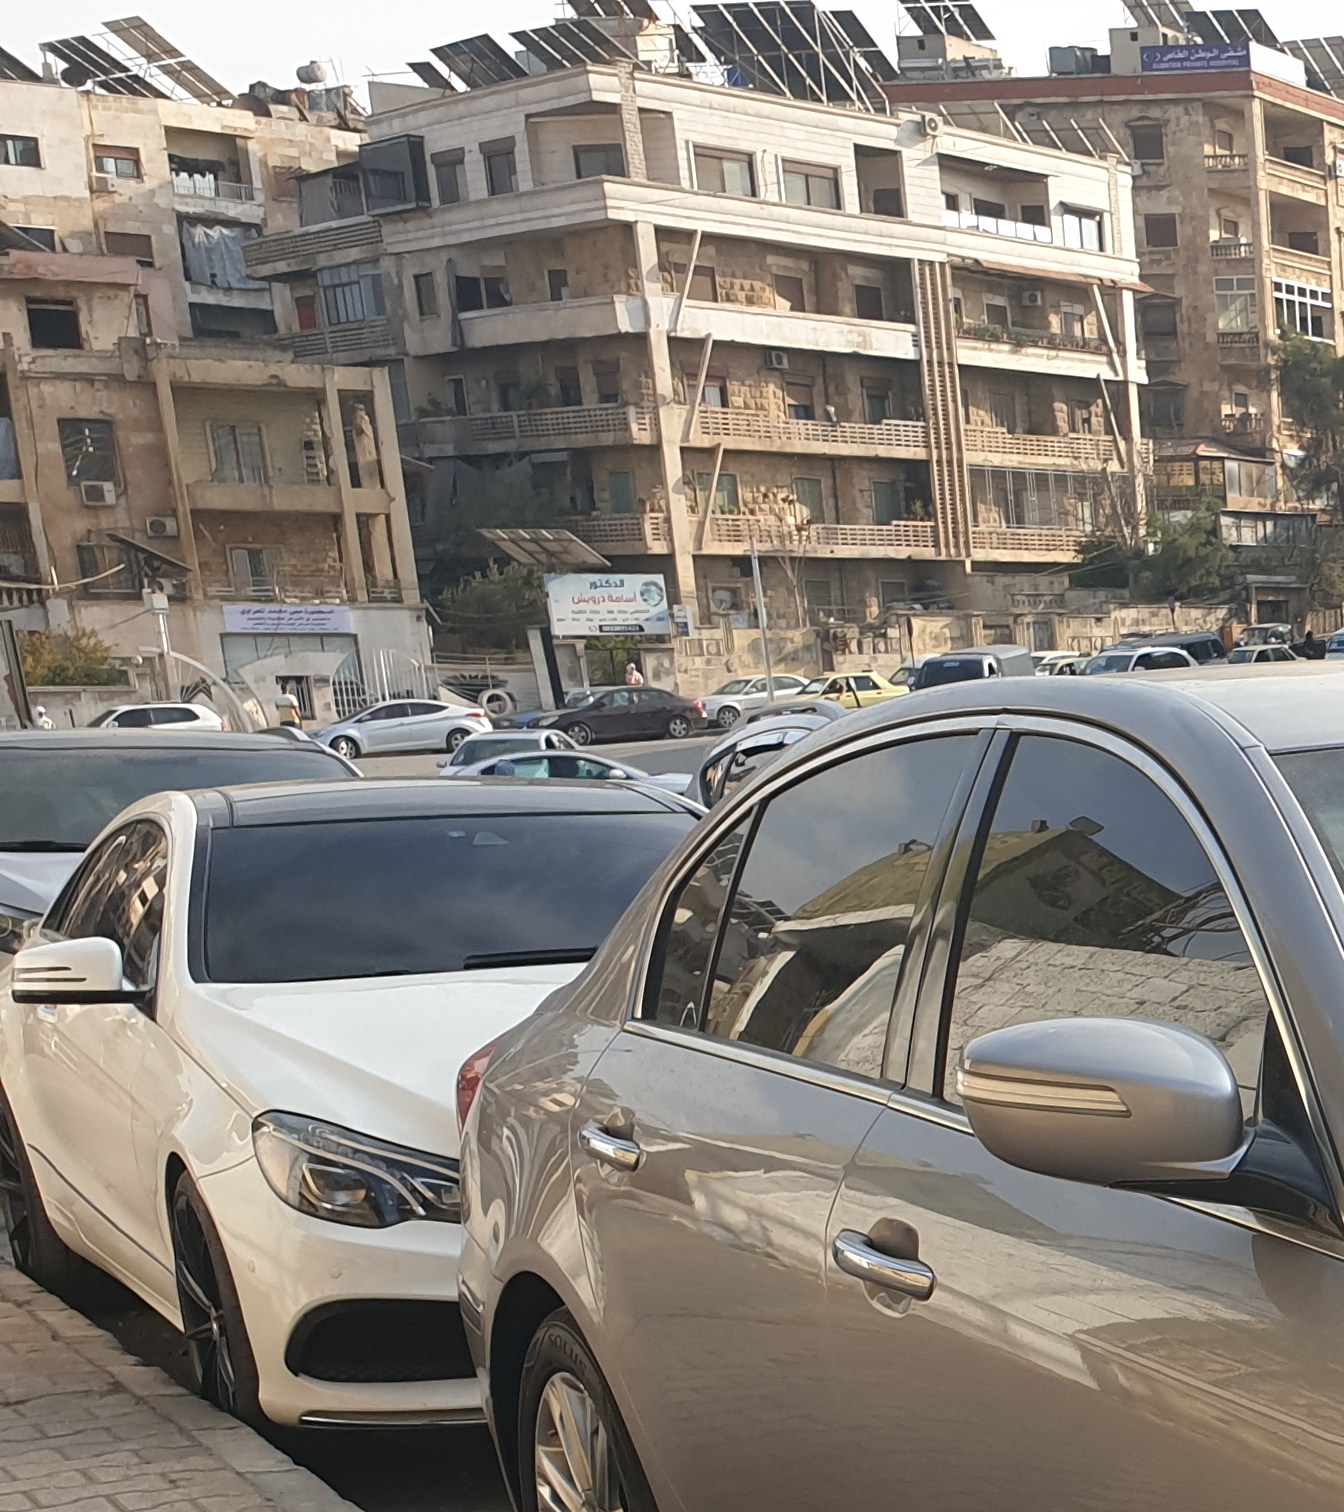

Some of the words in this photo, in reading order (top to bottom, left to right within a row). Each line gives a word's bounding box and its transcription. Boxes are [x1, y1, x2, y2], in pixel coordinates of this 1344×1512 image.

[589, 578, 625, 590] الدكتور
[571, 592, 606, 605] درويش
[608, 591, 638, 603] أسامة
[548, 1333, 588, 1377] SOLUS
